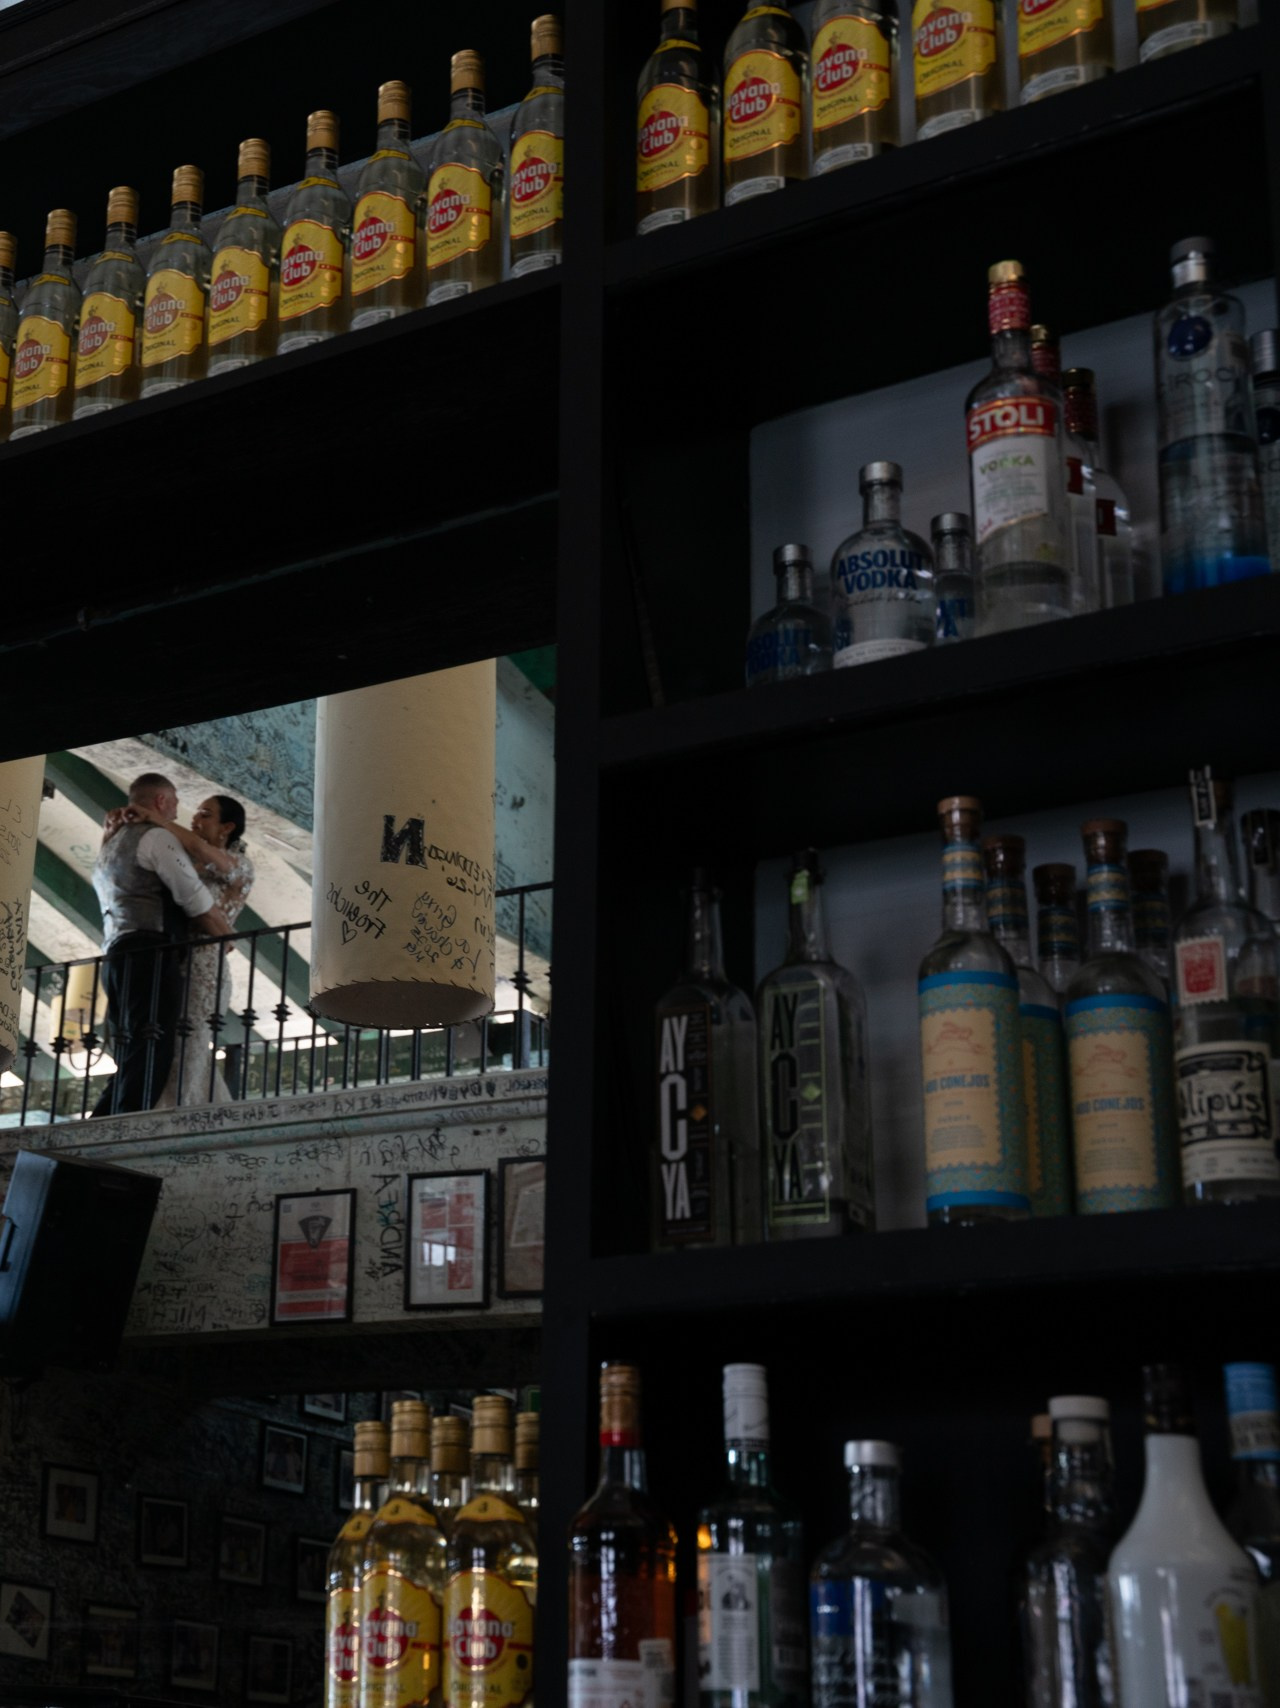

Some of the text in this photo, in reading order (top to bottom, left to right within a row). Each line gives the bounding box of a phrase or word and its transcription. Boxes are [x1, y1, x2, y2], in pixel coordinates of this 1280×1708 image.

[730, 96, 767, 122] Club
[969, 404, 1046, 442] STOLI
[837, 548, 925, 579] ABSOLUT
[843, 567, 918, 595] VODKA
